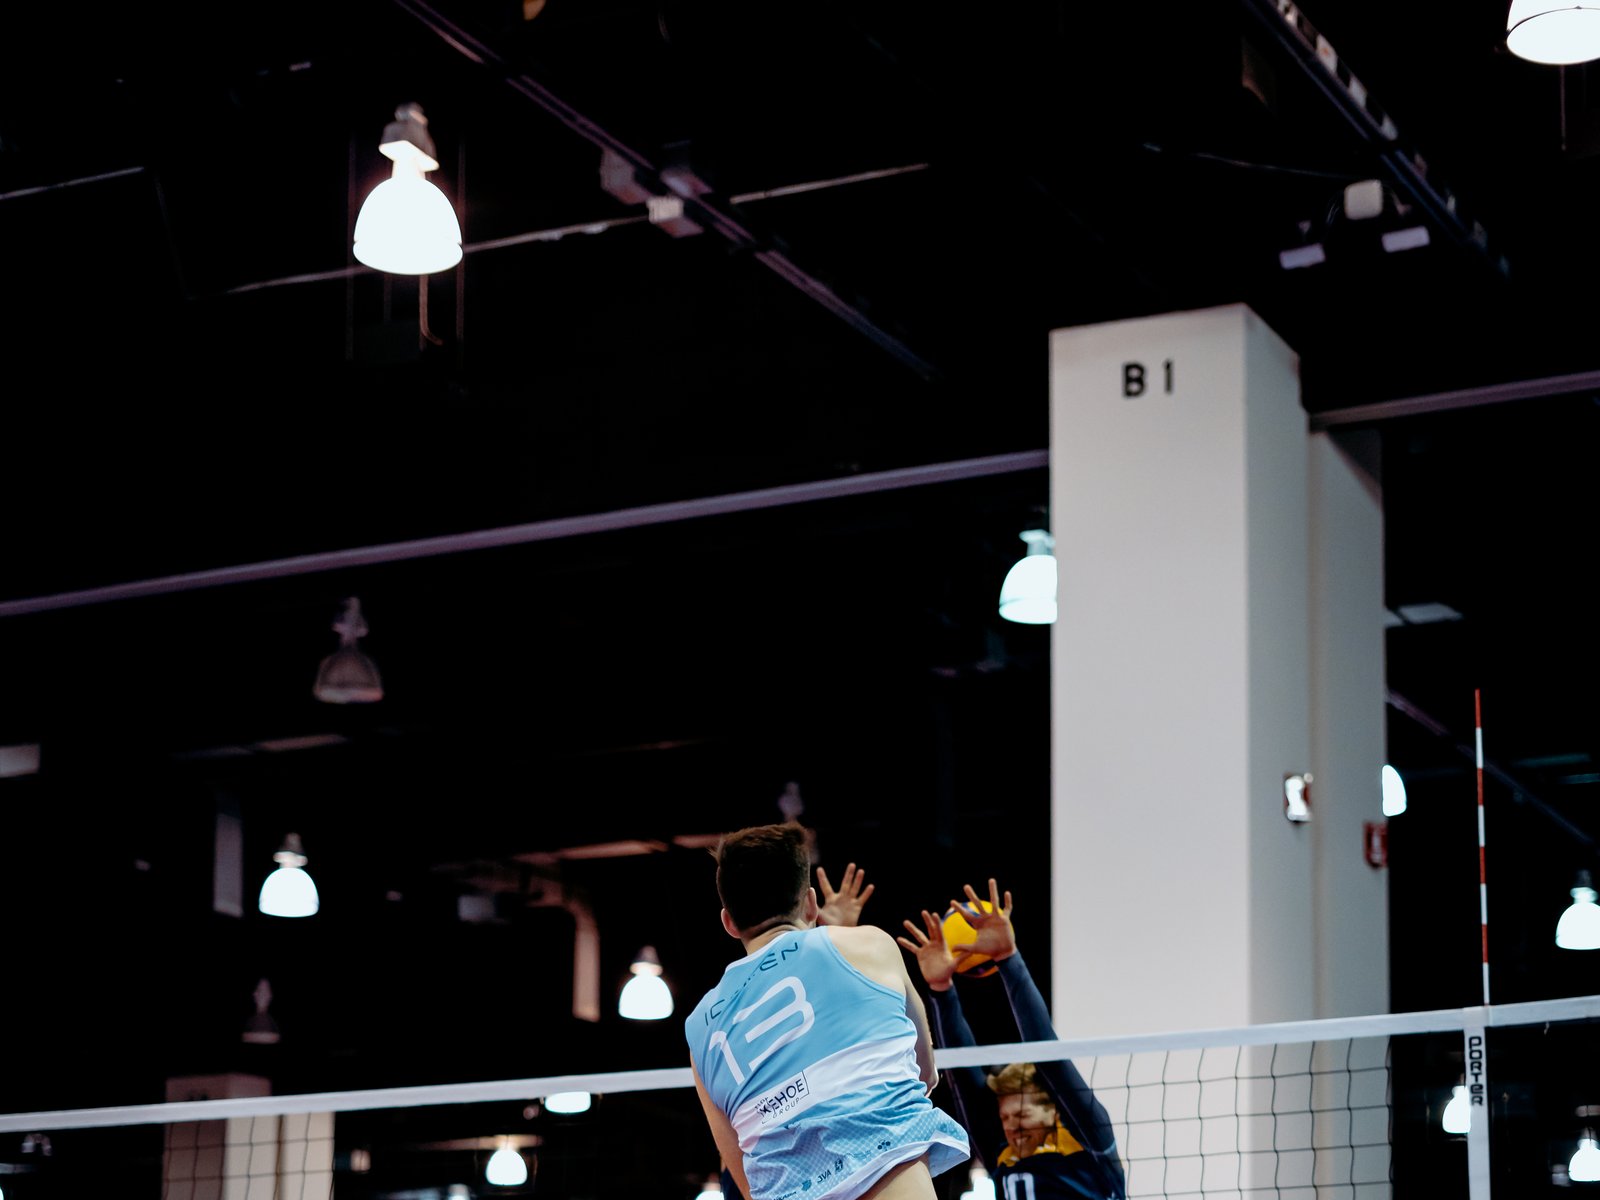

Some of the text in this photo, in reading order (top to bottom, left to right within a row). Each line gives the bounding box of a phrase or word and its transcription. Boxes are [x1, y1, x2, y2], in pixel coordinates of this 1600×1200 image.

[1121, 361, 1146, 398] B
[704, 942, 799, 1026] ICEN
[709, 975, 816, 1086] 13
[759, 1078, 804, 1114] KEHOE
